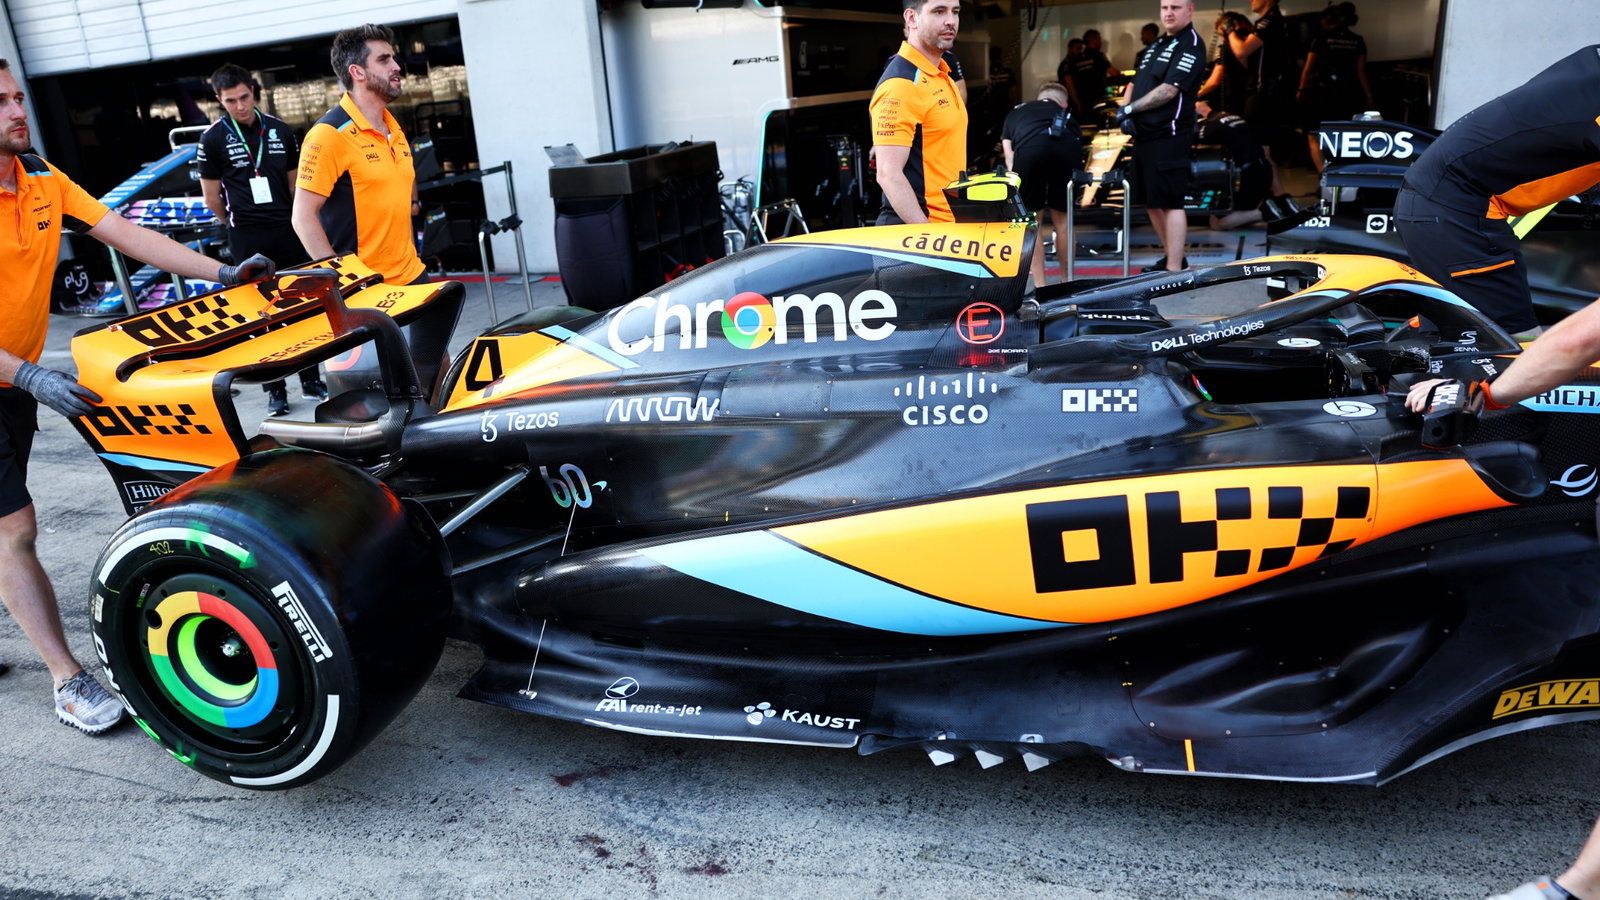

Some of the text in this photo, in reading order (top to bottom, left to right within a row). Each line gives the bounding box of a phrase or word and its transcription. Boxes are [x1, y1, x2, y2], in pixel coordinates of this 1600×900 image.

[902, 233, 1012, 262] cādence
[607, 288, 898, 356] Chrome
[1151, 319, 1265, 352] DELL Technologies
[1535, 389, 1600, 407] RICH
[506, 411, 560, 431] Tezos
[271, 580, 334, 663] PIRELLI
[630, 702, 702, 717] rent-a-jet
[781, 708, 860, 730] KAUST
